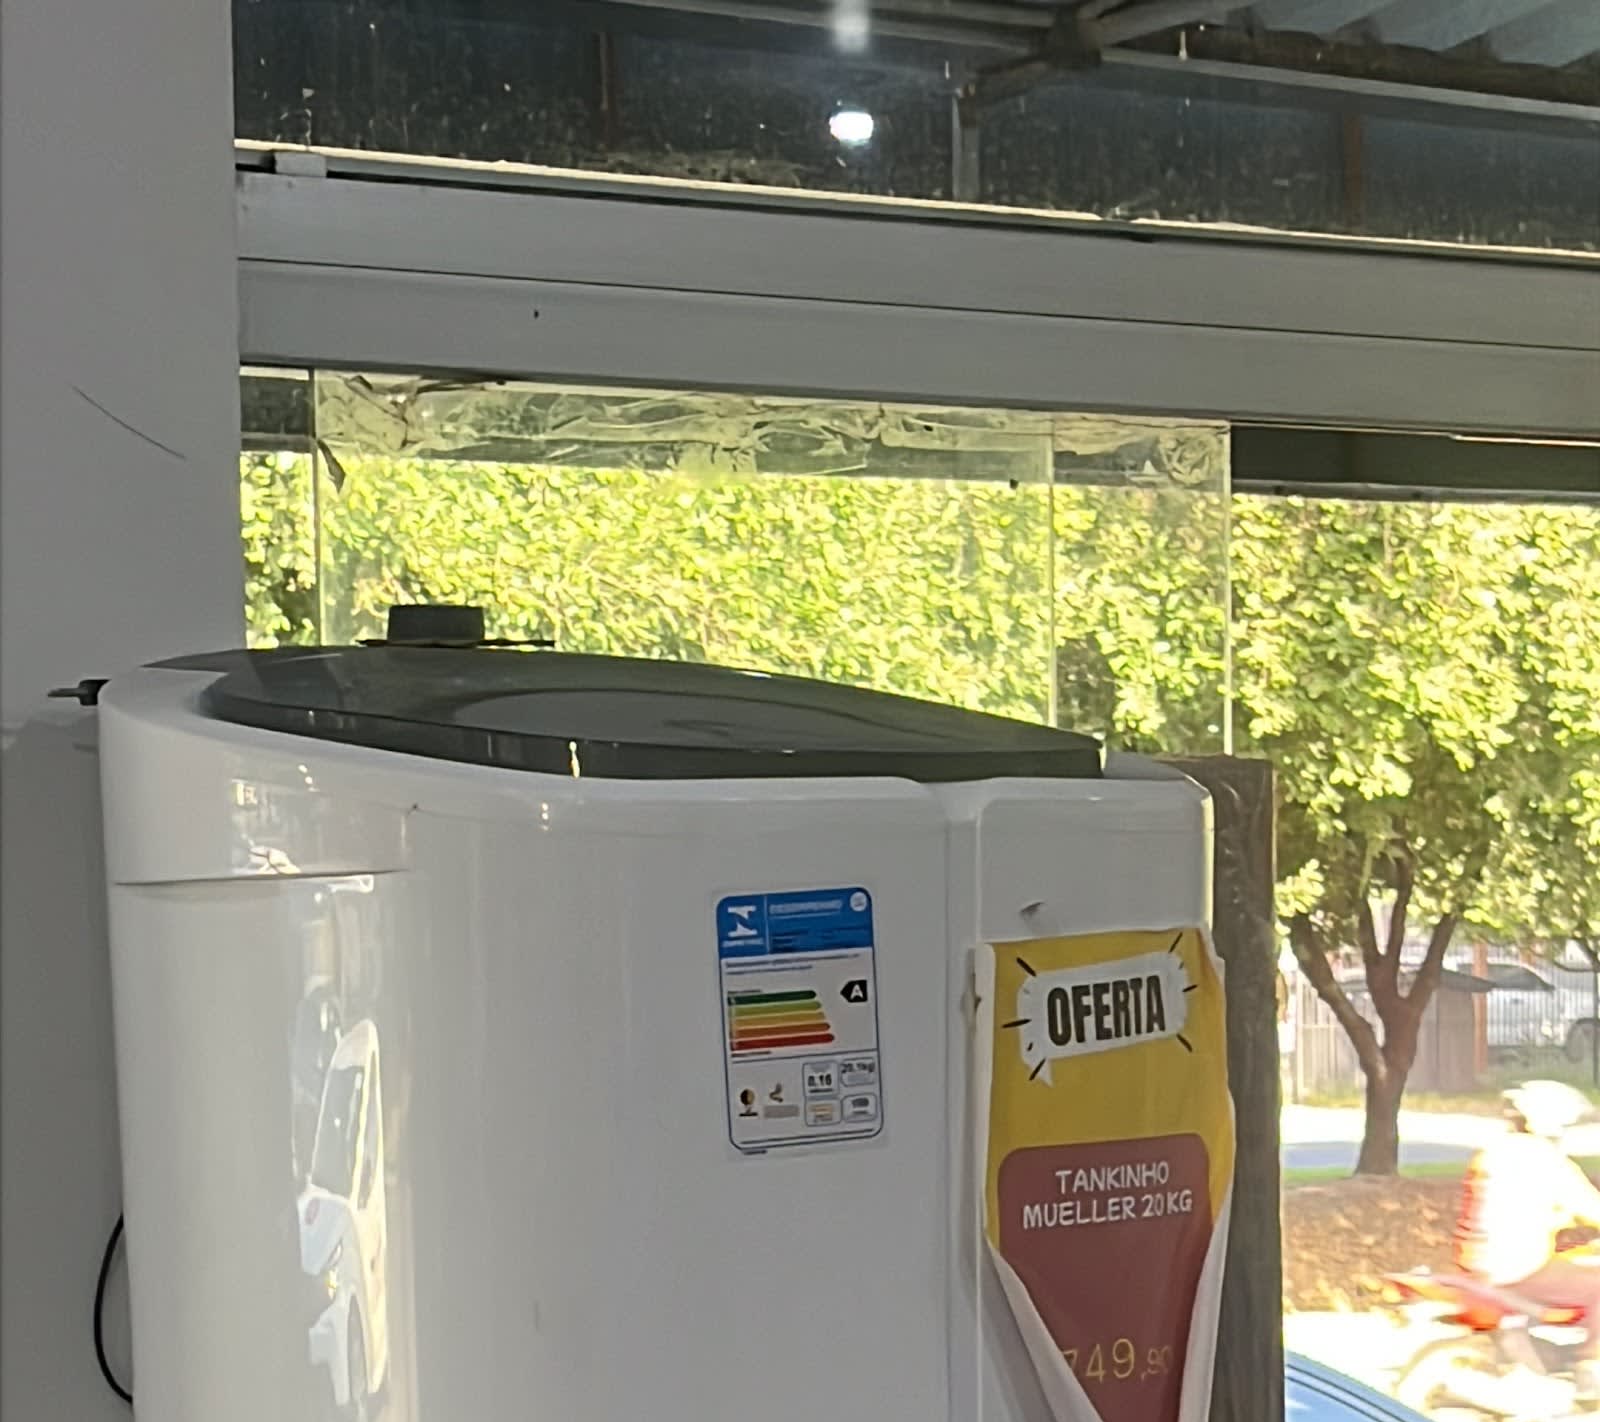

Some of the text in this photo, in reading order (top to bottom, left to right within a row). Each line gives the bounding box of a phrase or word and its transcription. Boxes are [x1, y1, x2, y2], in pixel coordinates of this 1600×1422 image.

[850, 984, 864, 1000] A
[1047, 975, 1166, 1046] OFERTA
[1055, 1161, 1169, 1194] TANKINHO
[1022, 1189, 1193, 1229] MUELLER 20KG
